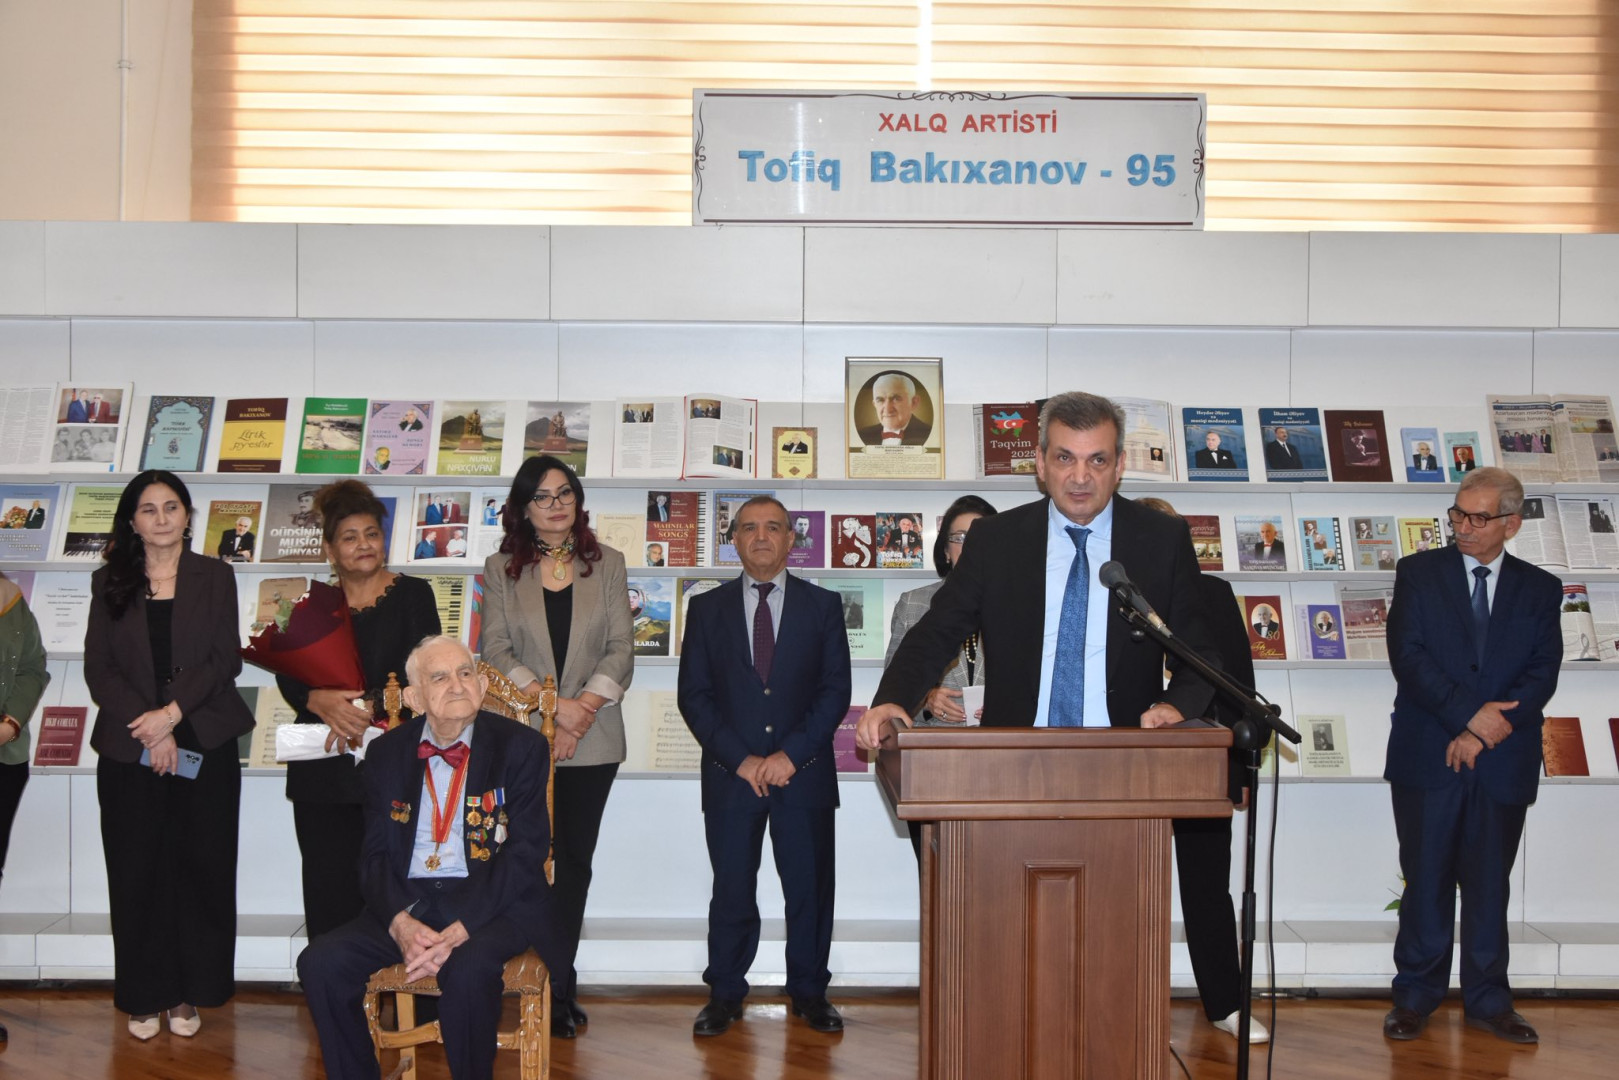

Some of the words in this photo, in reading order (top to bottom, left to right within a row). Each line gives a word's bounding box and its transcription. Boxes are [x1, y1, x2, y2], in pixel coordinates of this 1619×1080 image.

[878, 112, 948, 133] XALQ
[961, 109, 1058, 133] ARTİSTİ
[738, 150, 841, 191] Tofiq
[870, 151, 1088, 186] Bakıxanov
[1127, 154, 1176, 186] 95
[990, 438, 1032, 449] Təqvim
[469, 455, 497, 463] NURLU
[1011, 450, 1036, 458] 2025
[447, 464, 493, 474] NAXÇIVAN
[1267, 630, 1280, 640] 80
